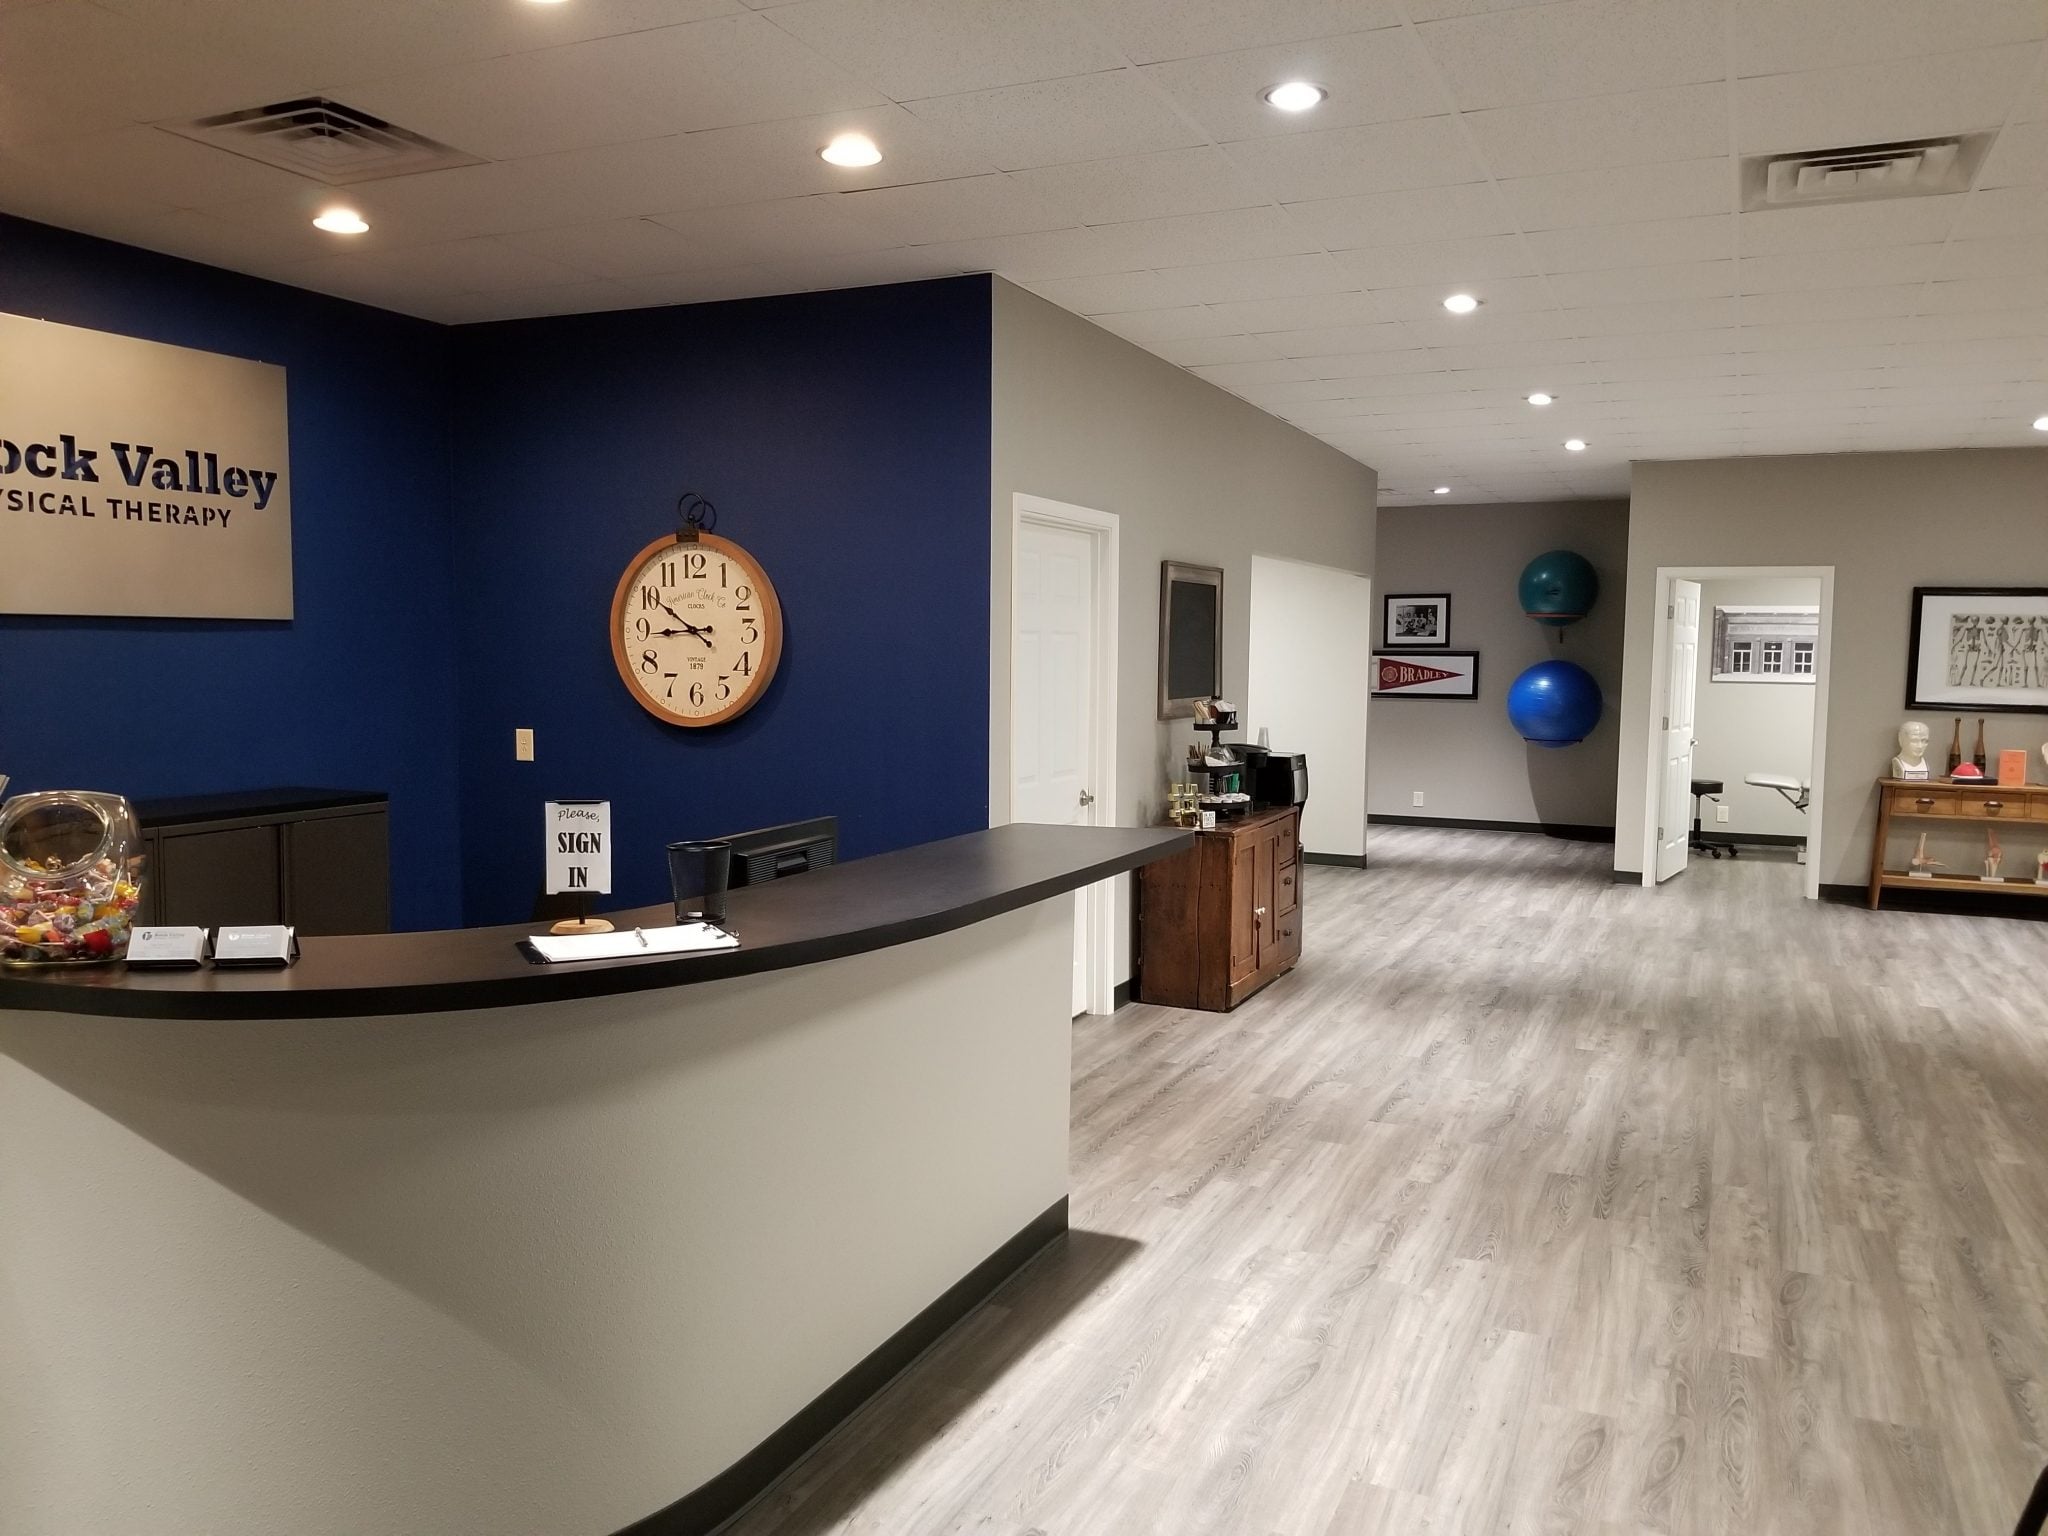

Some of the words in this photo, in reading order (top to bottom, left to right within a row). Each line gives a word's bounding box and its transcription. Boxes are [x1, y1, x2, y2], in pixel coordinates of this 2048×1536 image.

[110, 442, 278, 510] Valley
[0, 489, 95, 517] SICAL
[106, 498, 232, 528] THERAPY
[660, 562, 676, 588] 11
[683, 553, 707, 579] 12
[718, 562, 728, 588] 1
[640, 585, 661, 611] 10
[735, 585, 752, 611] 2
[635, 617, 651, 642] 9
[740, 618, 758, 645] 3
[641, 649, 659, 675] 8
[732, 651, 752, 677] 4
[1400, 666, 1449, 683] BRADLEY
[664, 673, 678, 698] 7
[689, 682, 704, 708] 6
[715, 675, 731, 701] 5
[557, 831, 602, 854] SIGN
[568, 866, 588, 888] IN
